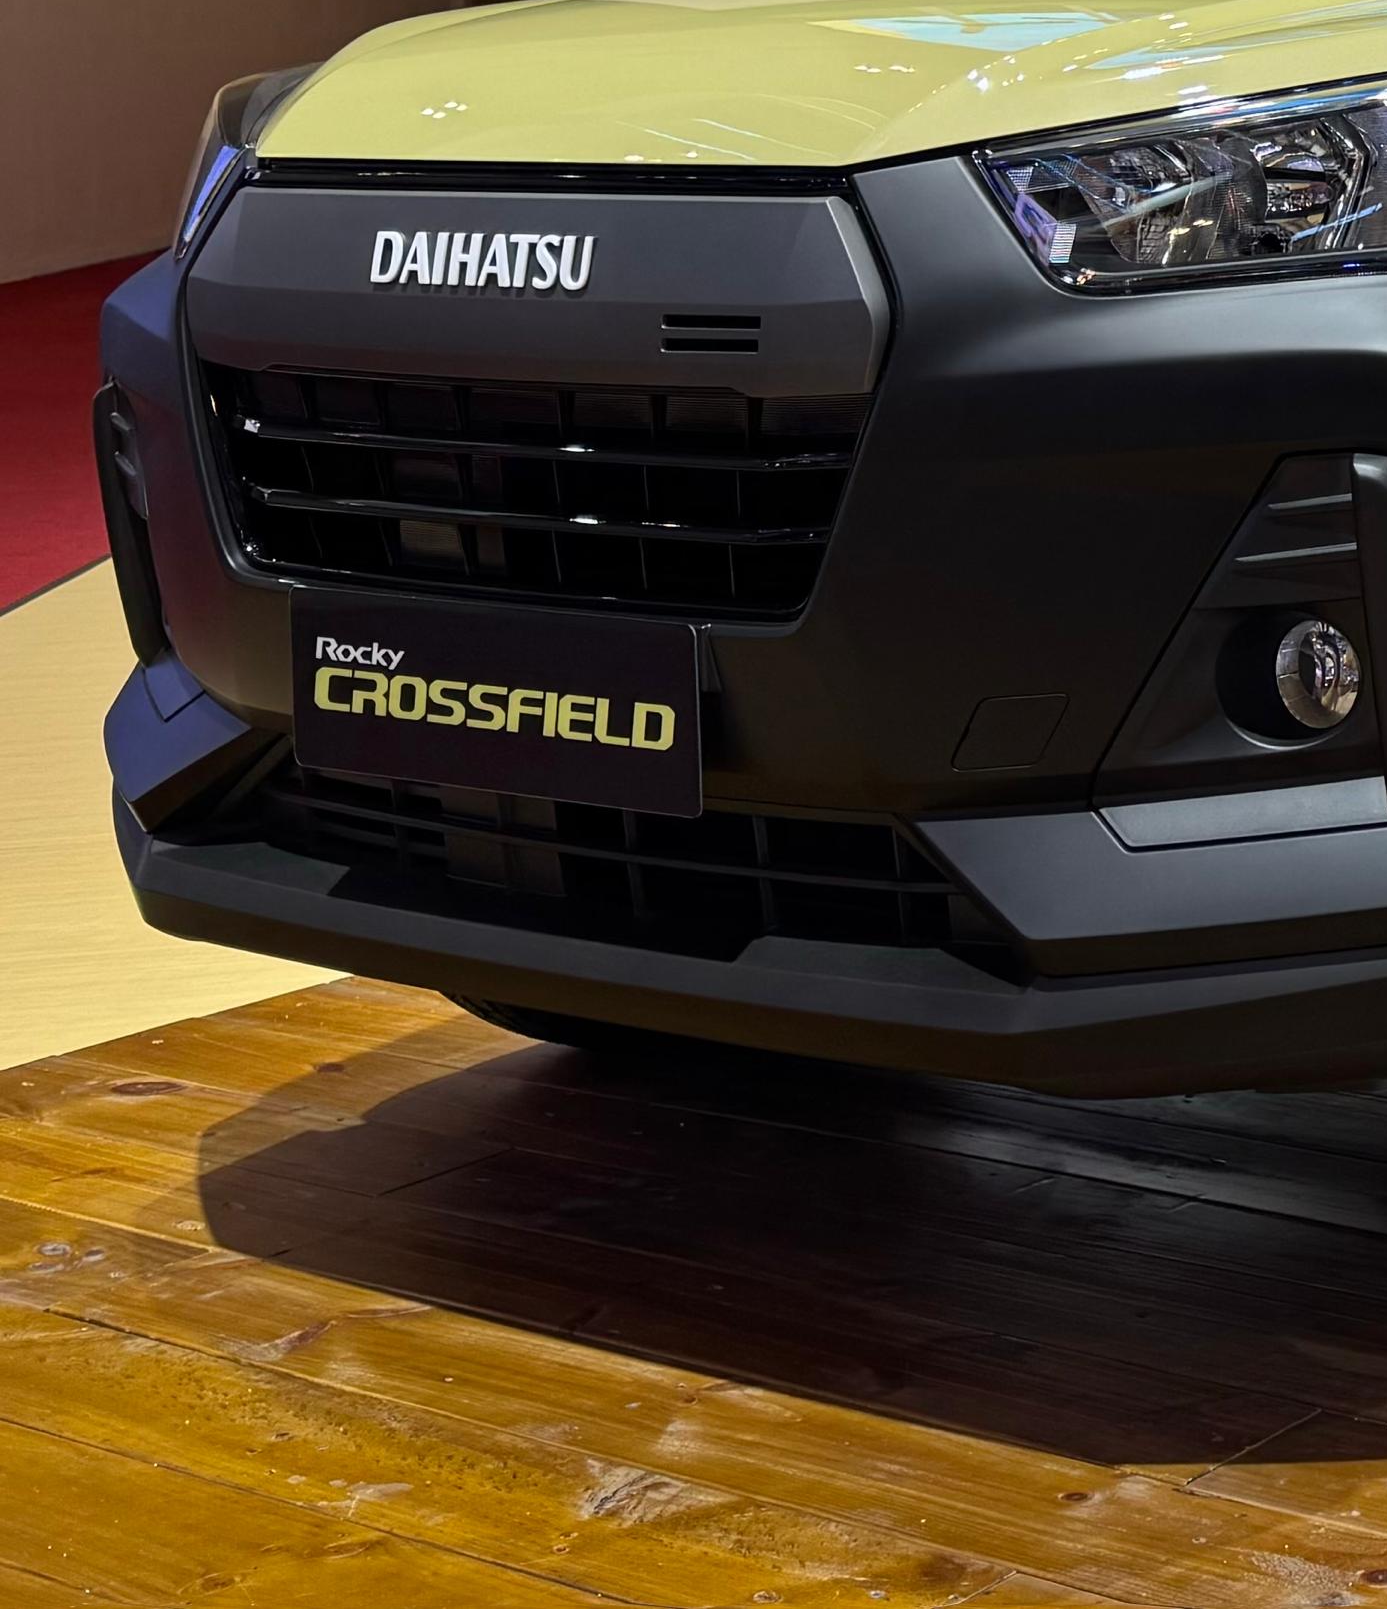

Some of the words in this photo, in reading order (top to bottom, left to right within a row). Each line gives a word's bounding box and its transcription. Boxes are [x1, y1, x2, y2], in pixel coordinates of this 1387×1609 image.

[369, 230, 595, 291] DAIHATSU
[315, 636, 405, 671] Rocky
[313, 666, 676, 752] CROSSFIELD
